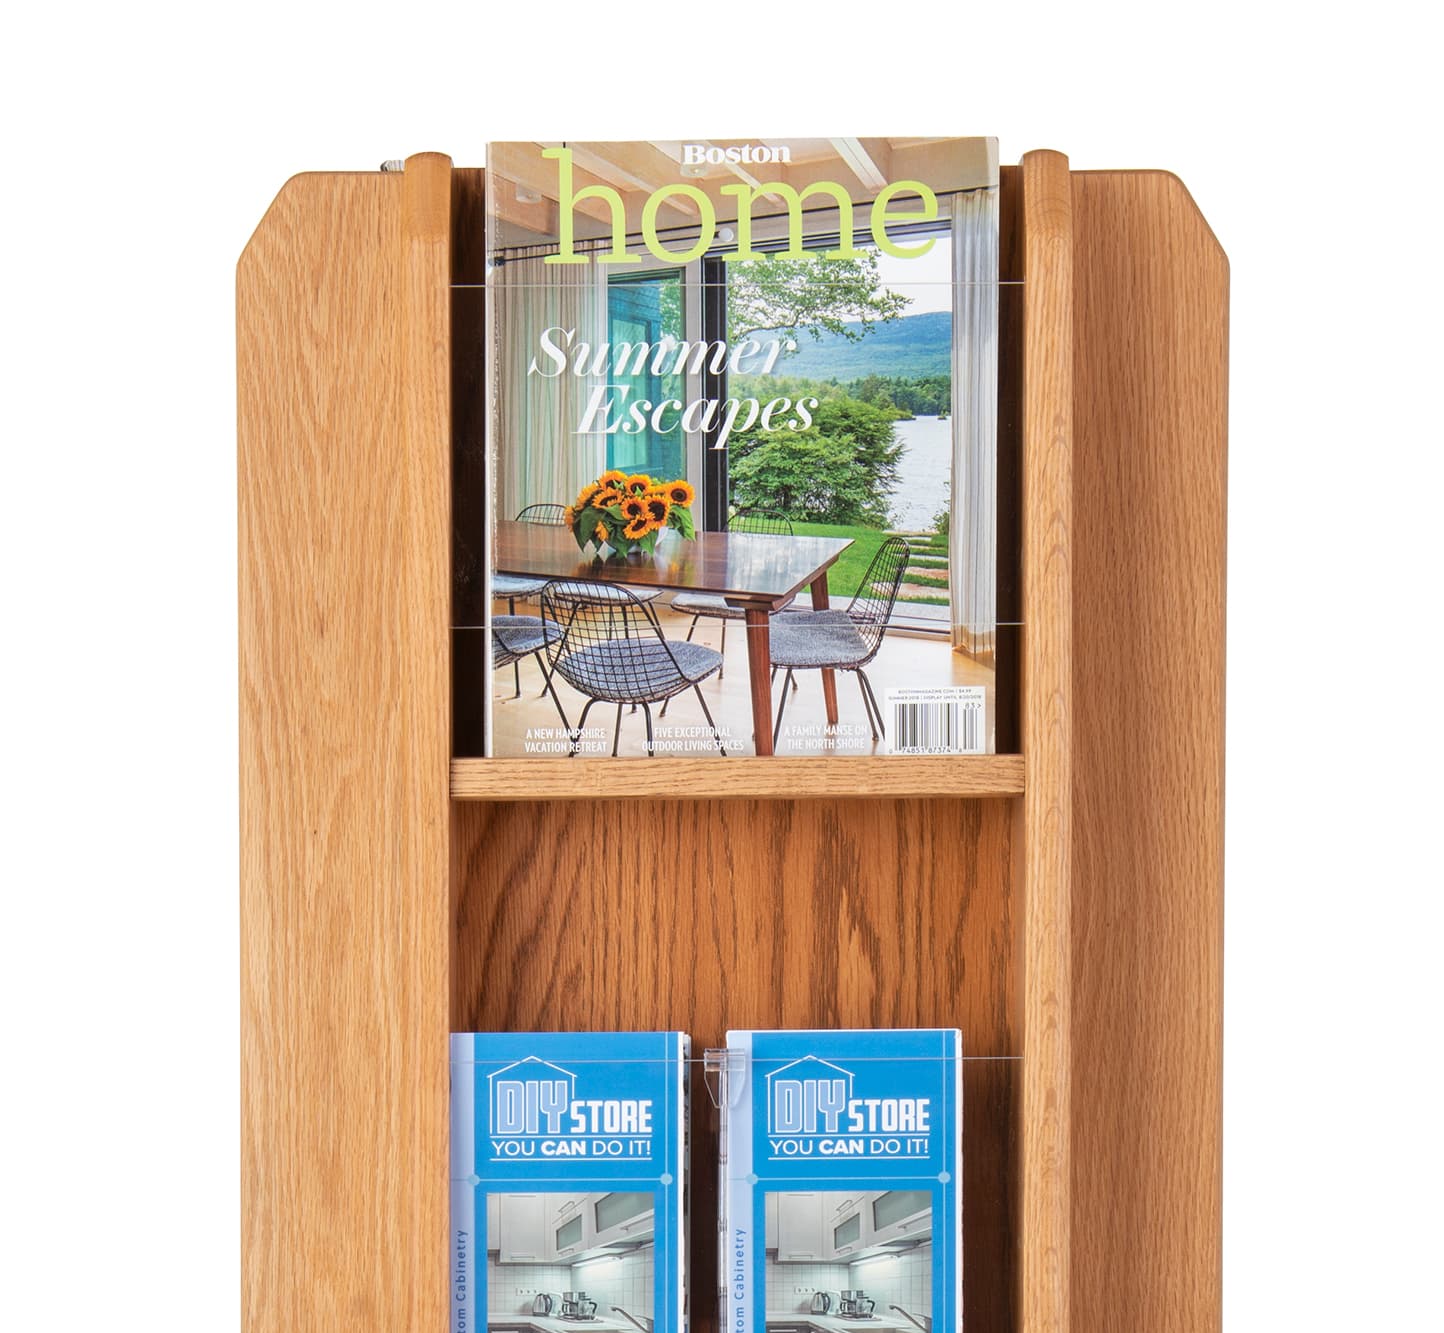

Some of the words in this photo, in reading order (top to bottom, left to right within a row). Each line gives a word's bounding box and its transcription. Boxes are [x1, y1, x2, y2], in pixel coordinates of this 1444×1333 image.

[683, 143, 791, 165] Boston
[541, 148, 939, 264] home
[527, 327, 797, 377] Summer
[571, 384, 819, 450] Escapes
[526, 729, 532, 739] A
[533, 729, 553, 739] NEW
[555, 728, 606, 738] HAMPSHIRE
[654, 728, 673, 737] FIVE
[675, 727, 731, 737] EXCEPTIONAL
[784, 727, 791, 736] A
[792, 726, 822, 736] FAMILY
[824, 725, 853, 736] MANSE
[854, 724, 868, 735] ON
[525, 742, 567, 752] VACATION
[569, 741, 607, 752] RETREAT
[642, 740, 683, 751] OUTDOOR
[685, 740, 712, 751] LIVING
[714, 740, 744, 750] SPACES
[788, 739, 804, 749] THE
[806, 738, 835, 749] NORTH
[836, 738, 865, 749] SHORE
[497, 1080, 568, 1134] DIY
[570, 1100, 653, 1133] STORE
[775, 1079, 846, 1133] DIY
[848, 1098, 931, 1132] STORE
[491, 1141, 535, 1156] YOU
[541, 1141, 586, 1155] CAN
[592, 1140, 623, 1155] DO
[629, 1140, 651, 1155] IT!
[769, 1139, 813, 1155] YOU
[818, 1139, 864, 1154] CAN
[870, 1139, 901, 1154] DO
[907, 1139, 928, 1154] IT!
[455, 1230, 469, 1301] Cabinetry
[734, 1229, 747, 1301] Cabinetry
